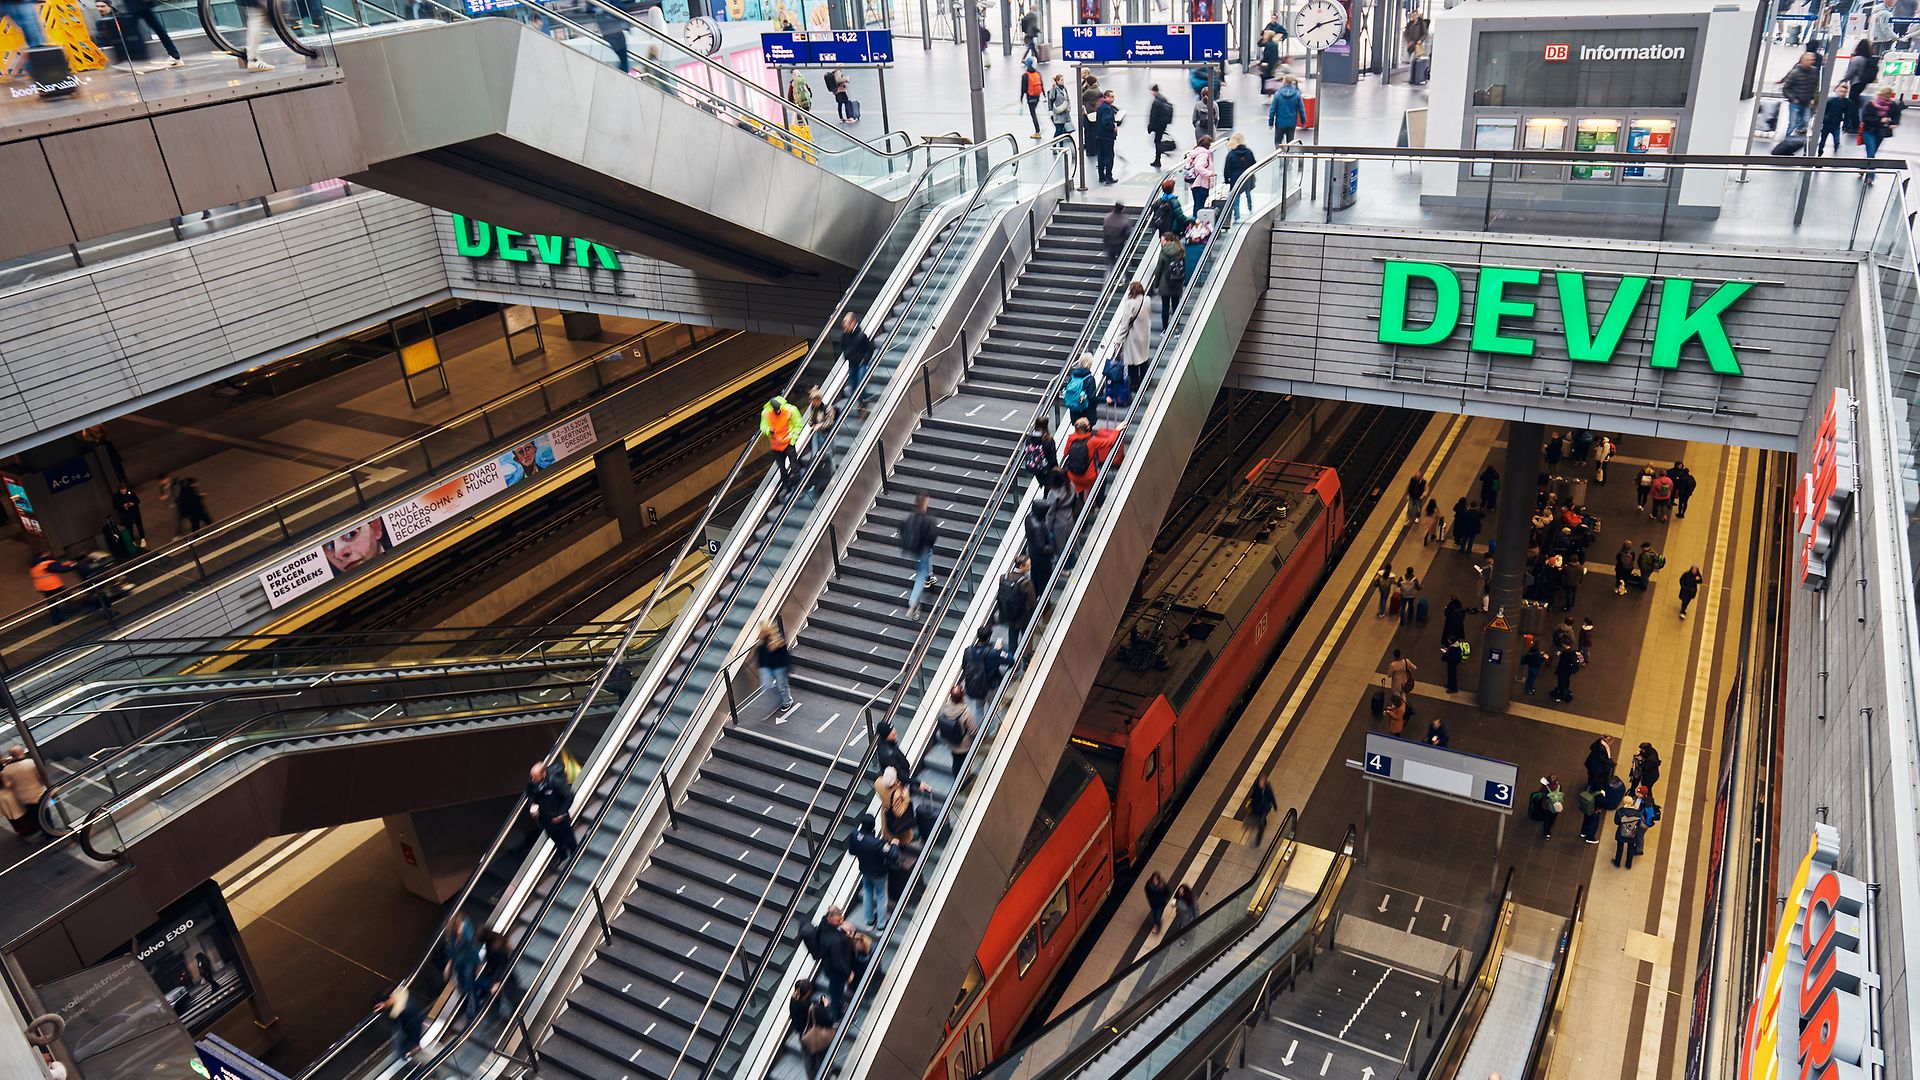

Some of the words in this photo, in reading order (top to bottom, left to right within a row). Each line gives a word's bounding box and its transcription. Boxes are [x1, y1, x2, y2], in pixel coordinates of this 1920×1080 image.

[1072, 26, 1093, 38] 11-16
[1546, 45, 1568, 59] DB
[1580, 44, 1686, 60] Information
[1377, 259, 1758, 376] DEVK
[554, 423, 591, 446] ALBERTINUM
[564, 431, 592, 449] DRESDEN
[463, 462, 497, 485] EDVARD
[388, 501, 419, 523] PAULA
[391, 495, 454, 532] MODERSOHN-
[457, 489, 464, 499] &
[465, 471, 499, 494] MUNCH
[394, 516, 432, 541] BECKER
[709, 540, 717, 552] 6
[266, 569, 282, 582] DIE
[282, 551, 318, 574] GROßEN
[269, 568, 305, 590] FRAGEN
[273, 584, 291, 598] DES
[291, 567, 324, 589] LEBENS
[1369, 754, 1382, 770] 4
[1494, 784, 1509, 801] 3
[137, 940, 165, 961] Volvo
[165, 919, 194, 942] EX90
[61, 960, 136, 1012] vollelektrische
